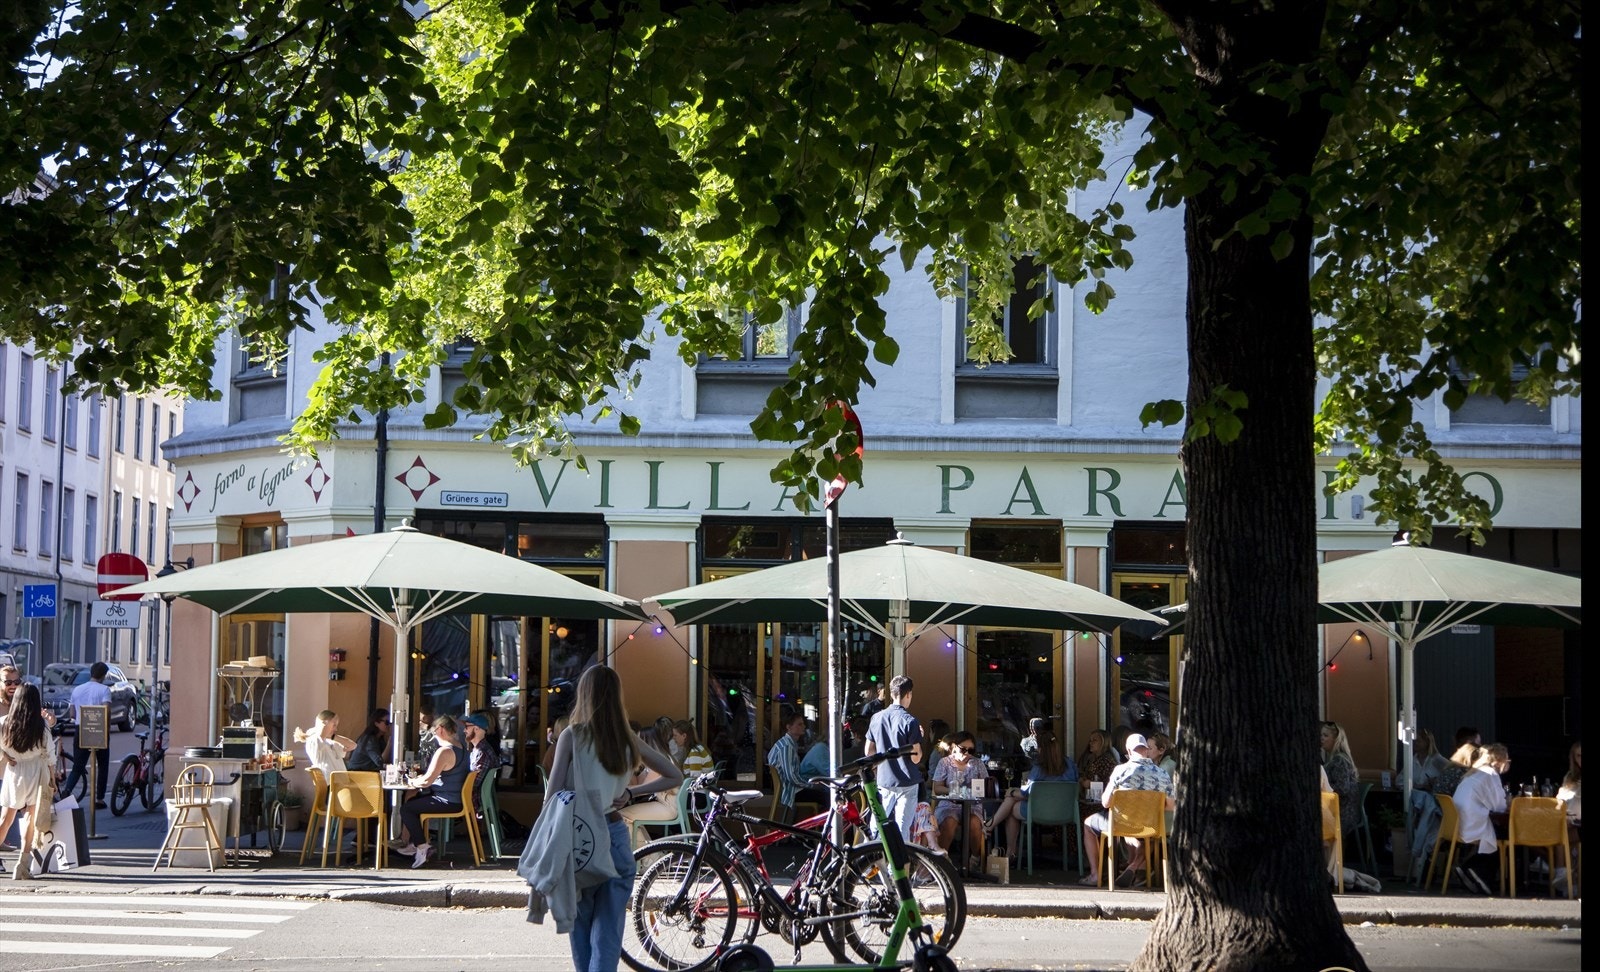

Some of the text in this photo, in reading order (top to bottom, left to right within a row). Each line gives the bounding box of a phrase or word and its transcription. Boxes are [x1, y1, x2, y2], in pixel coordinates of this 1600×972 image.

[209, 459, 295, 514] forno a legna
[445, 493, 503, 506] Grüners gate
[935, 464, 1505, 523] PARAIO
